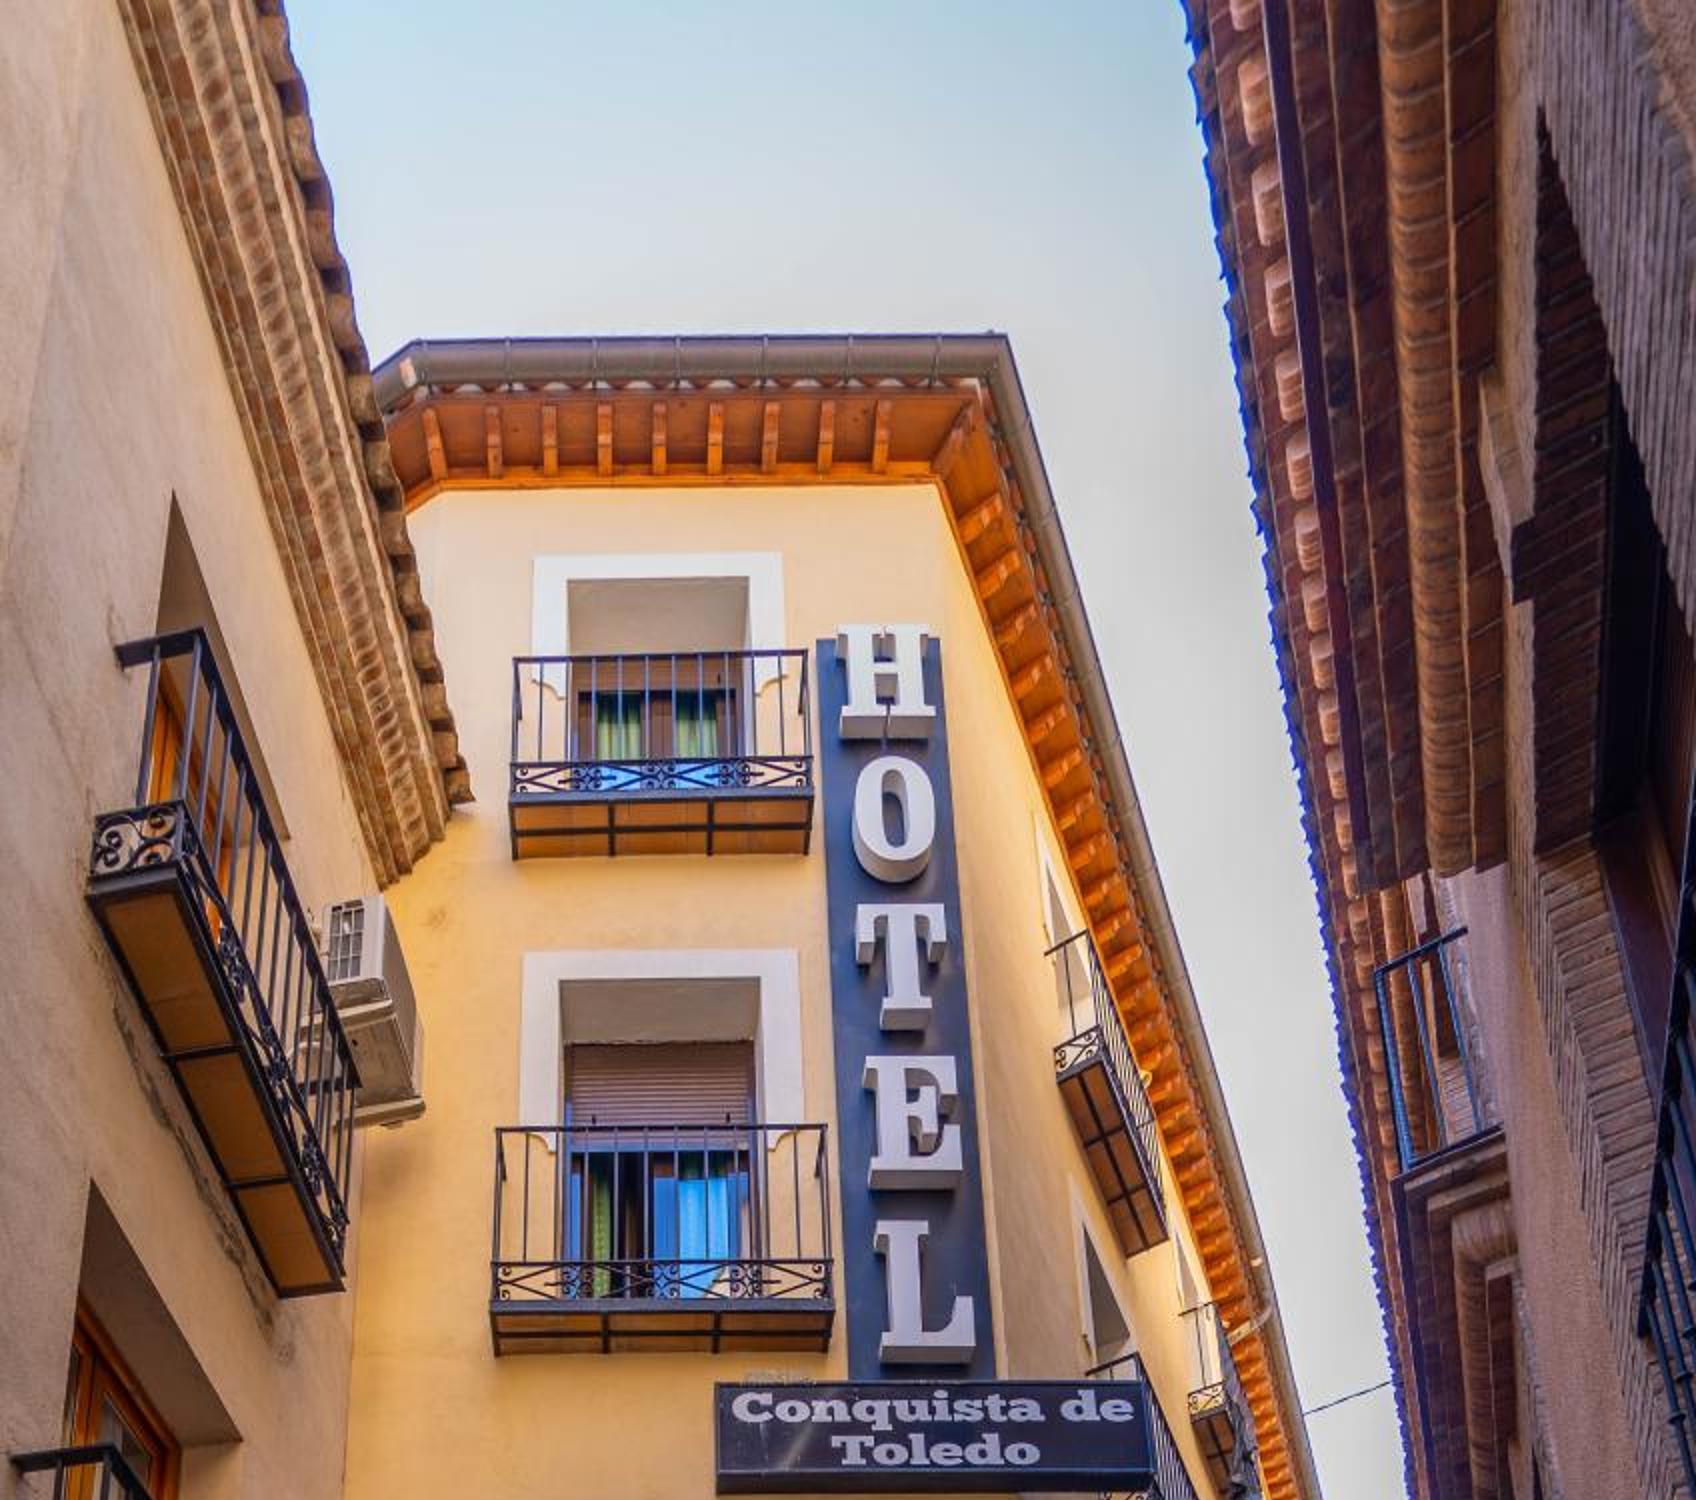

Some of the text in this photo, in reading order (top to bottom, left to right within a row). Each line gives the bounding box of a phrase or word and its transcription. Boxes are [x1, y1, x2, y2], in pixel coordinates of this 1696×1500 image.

[836, 624, 977, 1364] HOTEL
[731, 1389, 1135, 1431] Conquista de
[831, 1433, 1041, 1466] Toledo
